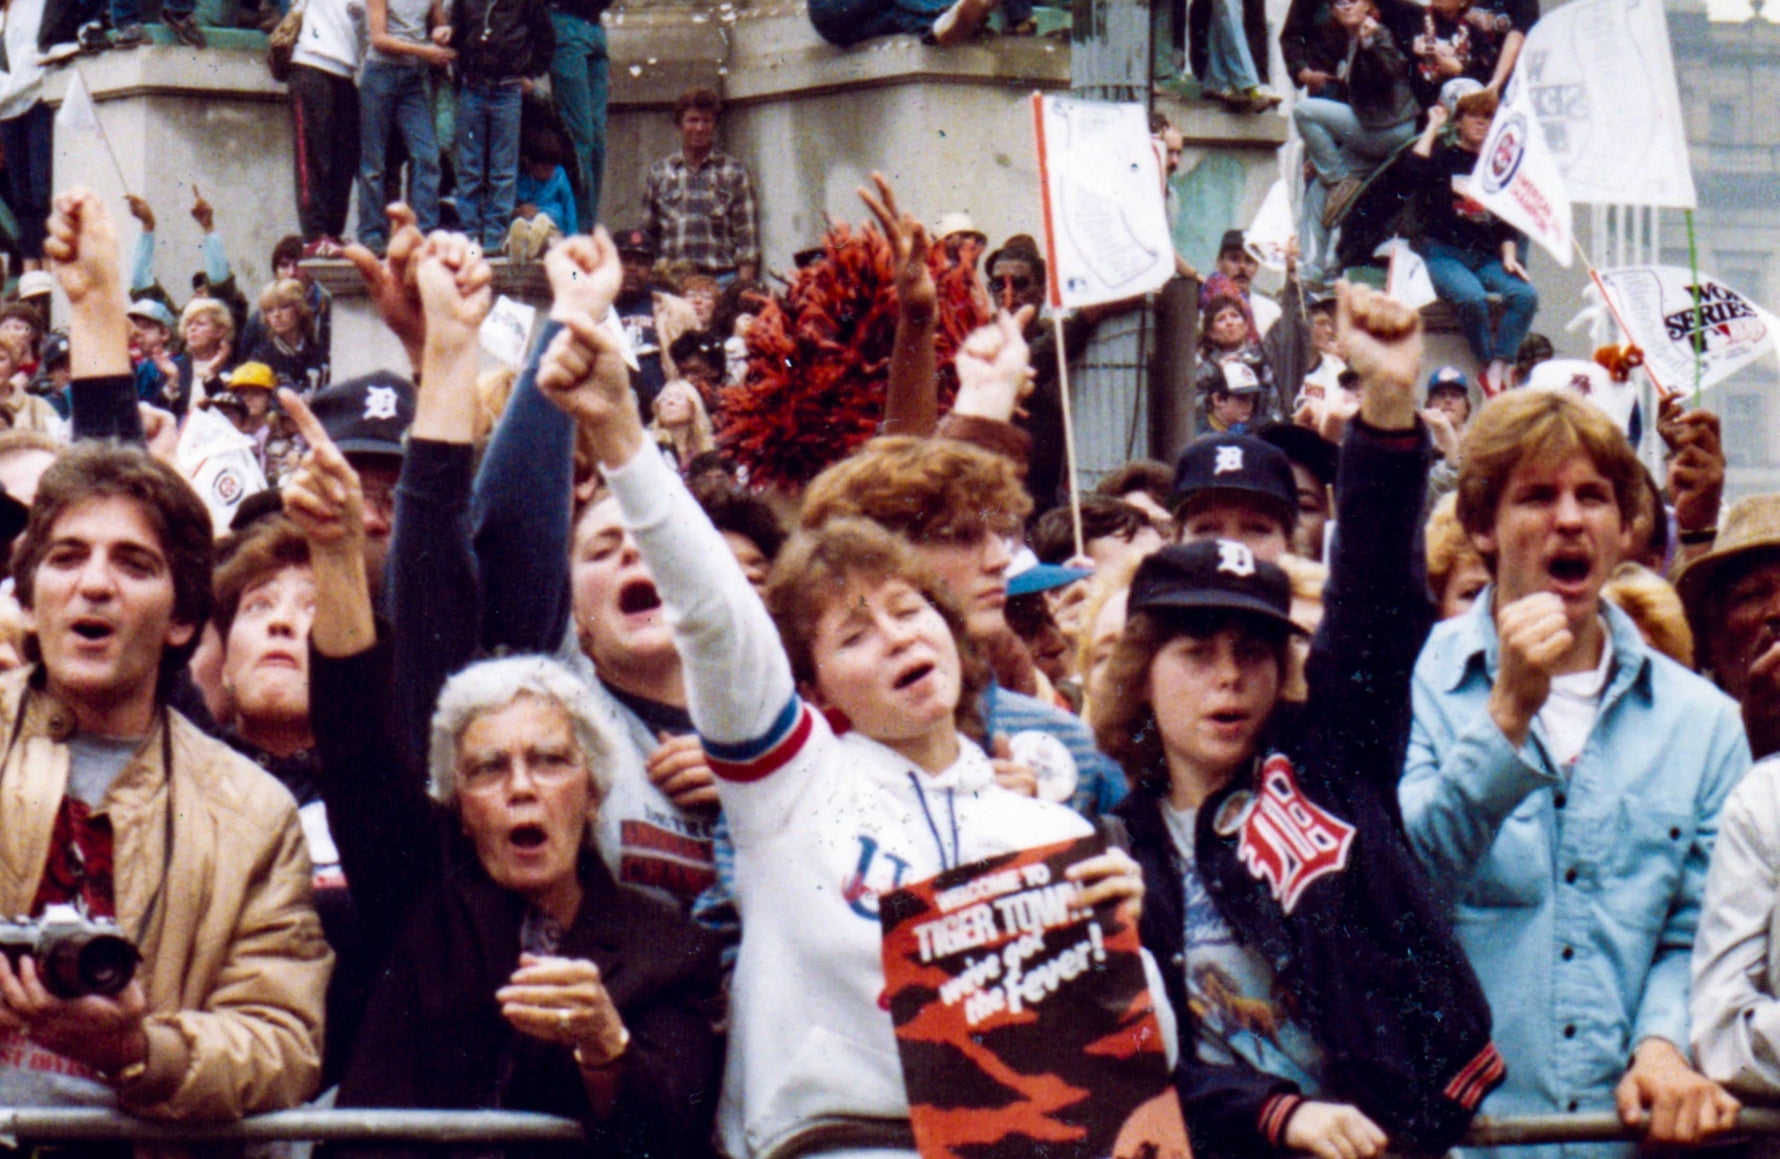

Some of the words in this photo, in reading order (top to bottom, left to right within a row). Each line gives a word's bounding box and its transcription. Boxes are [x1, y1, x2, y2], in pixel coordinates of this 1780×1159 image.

[364, 385, 399, 421] D
[1214, 444, 1244, 476] D
[1215, 538, 1256, 577] D
[1019, 862, 1051, 888] TO
[913, 902, 999, 962] TIGER
